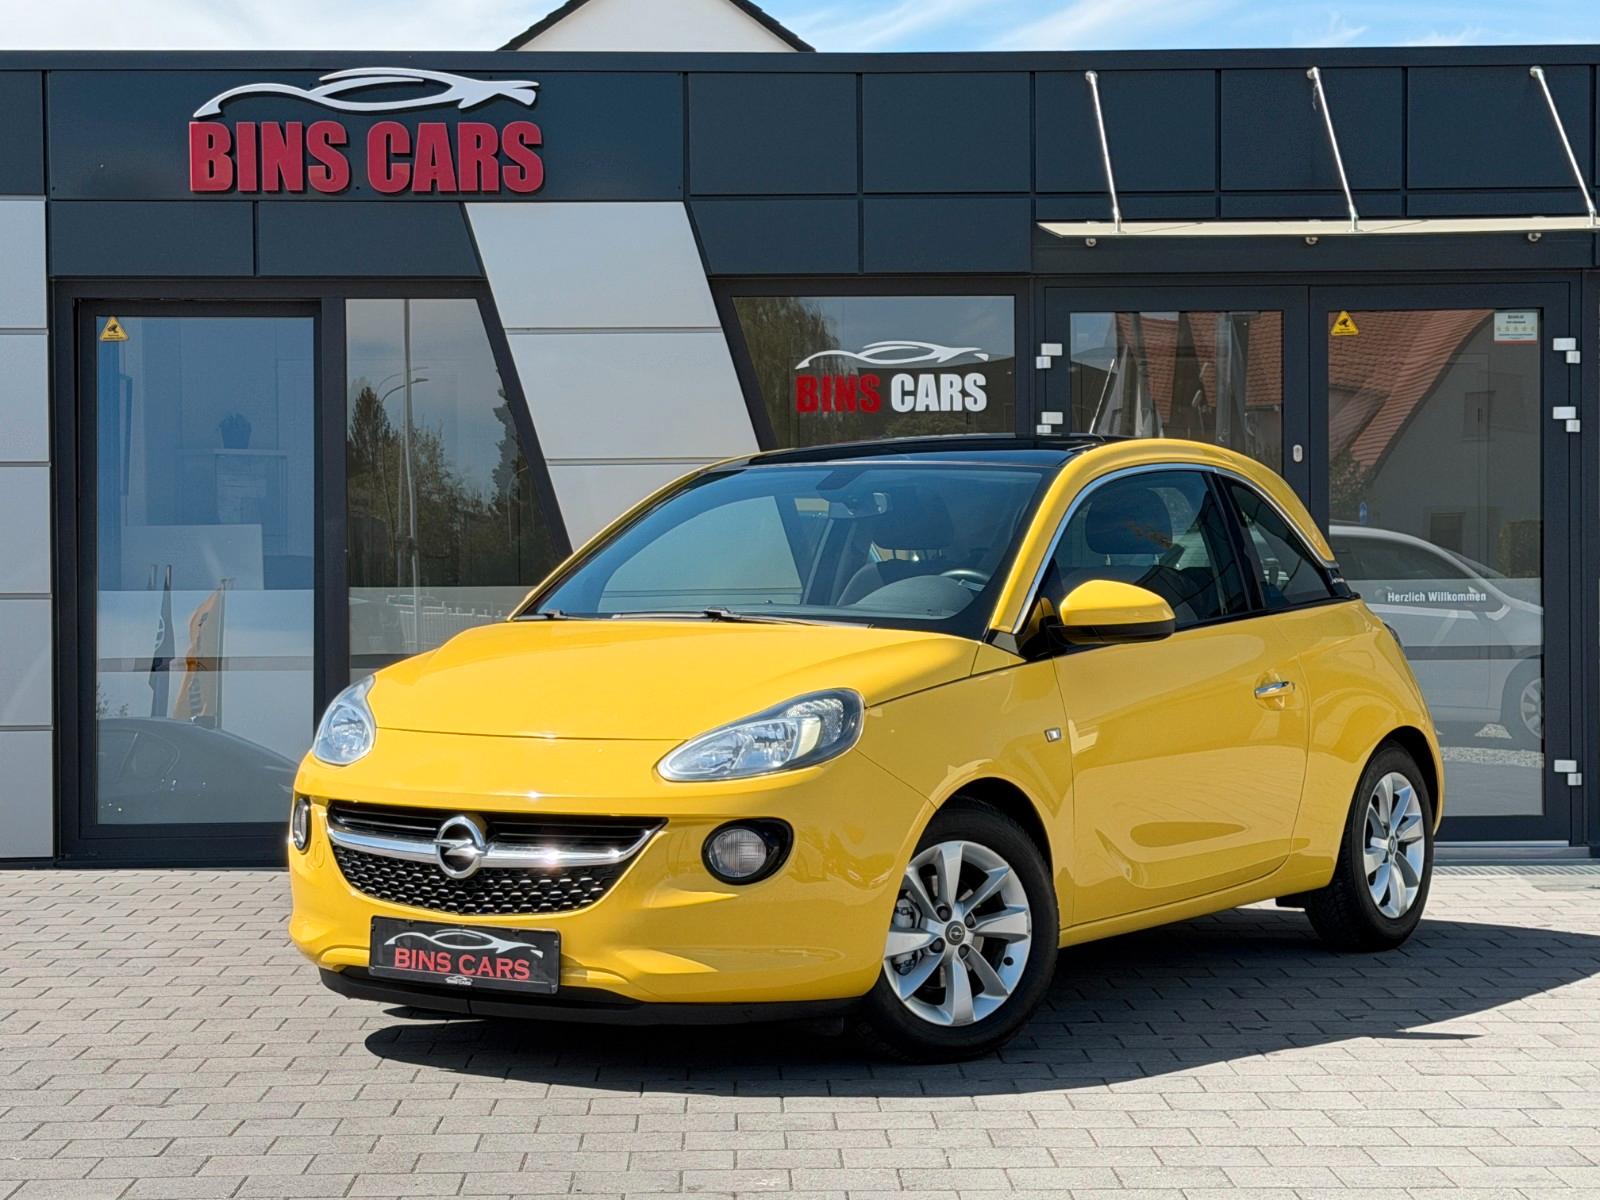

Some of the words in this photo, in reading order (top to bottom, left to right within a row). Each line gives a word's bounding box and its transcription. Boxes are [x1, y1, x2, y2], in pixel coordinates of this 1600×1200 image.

[189, 121, 349, 193] BINS
[367, 121, 544, 193] CARS
[795, 373, 882, 414] BINS
[891, 372, 987, 413] CARS
[1387, 592, 1425, 602] Herzlich
[1428, 592, 1486, 602] Willkommen
[394, 947, 451, 973] BINS
[458, 954, 530, 980] CARS
